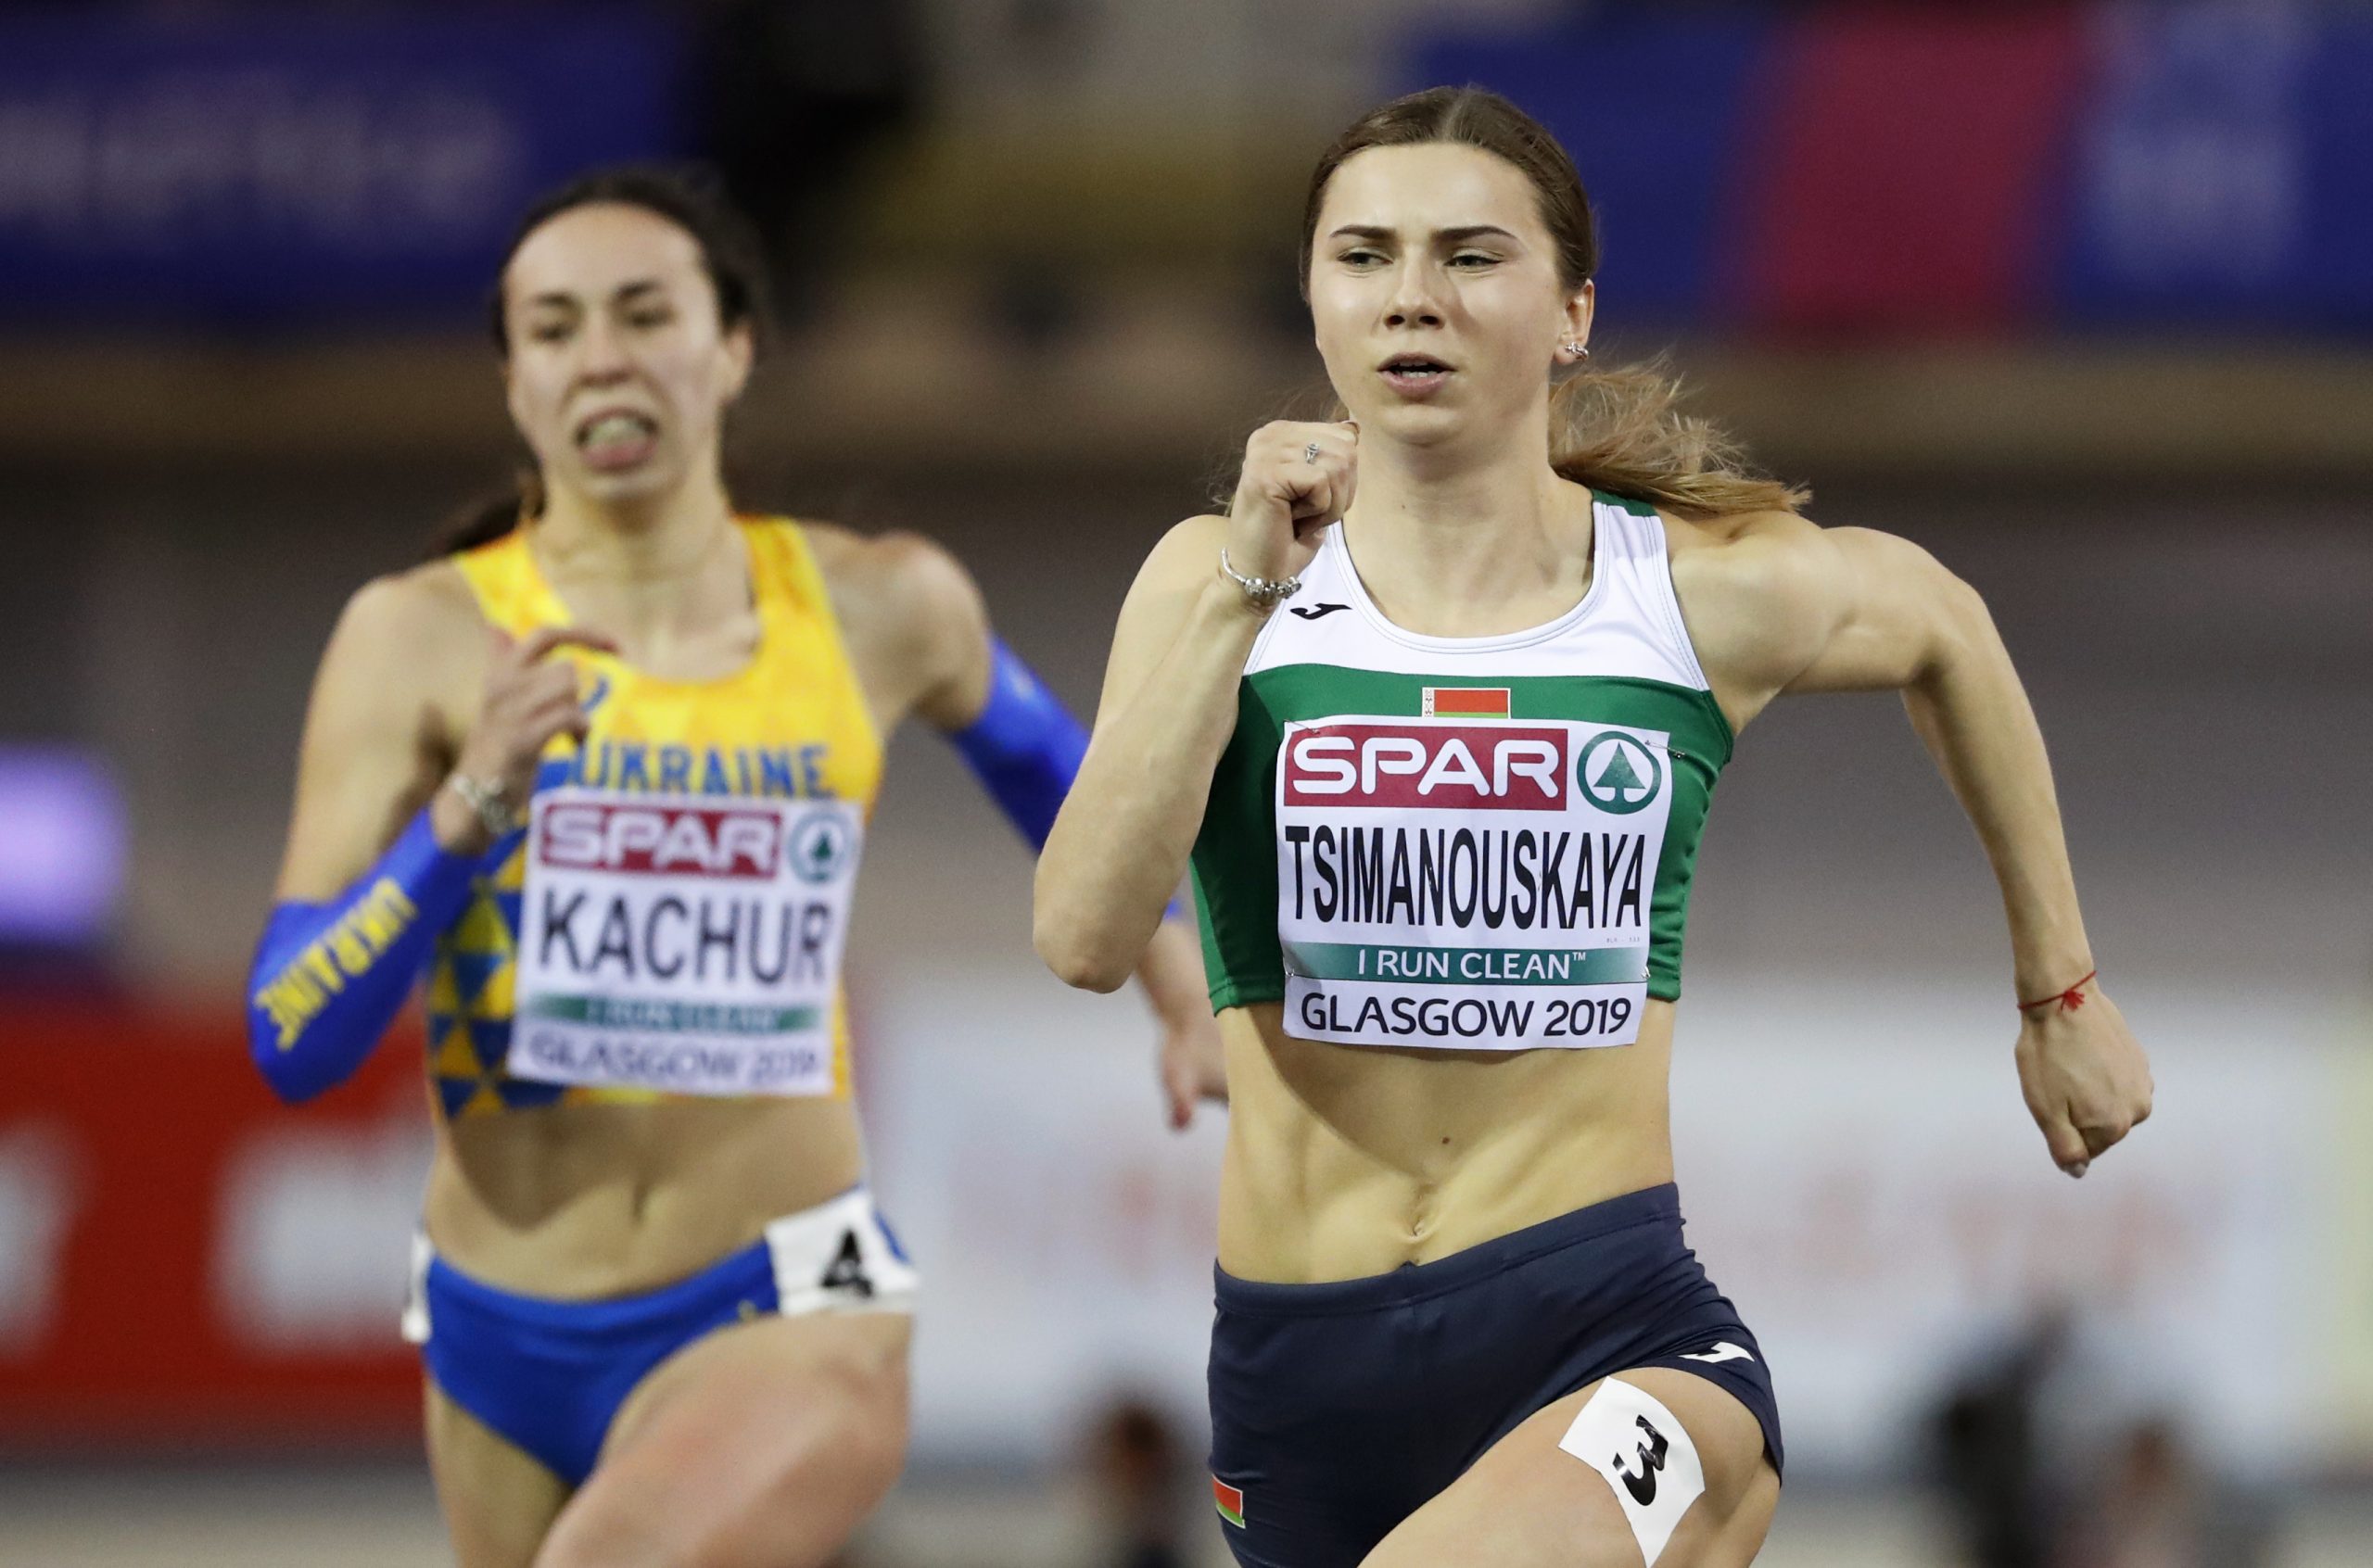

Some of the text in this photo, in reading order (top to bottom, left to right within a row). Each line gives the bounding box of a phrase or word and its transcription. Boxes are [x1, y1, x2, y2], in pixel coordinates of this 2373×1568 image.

[567, 743, 836, 799] UKRAINE
[1293, 735, 1559, 799] SPAR
[548, 807, 775, 876] SPAR
[1285, 824, 1646, 930] TSIMANOUSKAYA
[253, 876, 416, 1053] UKRAINE
[540, 886, 831, 985] KACHUR
[1357, 949, 1366, 976] I
[1377, 950, 1450, 979] RUN
[1301, 991, 1631, 1038] GLASGOW 2019
[530, 1030, 737, 1080] GLASGOW
[819, 1225, 874, 1298] 4
[1611, 1413, 1669, 1507] 3
